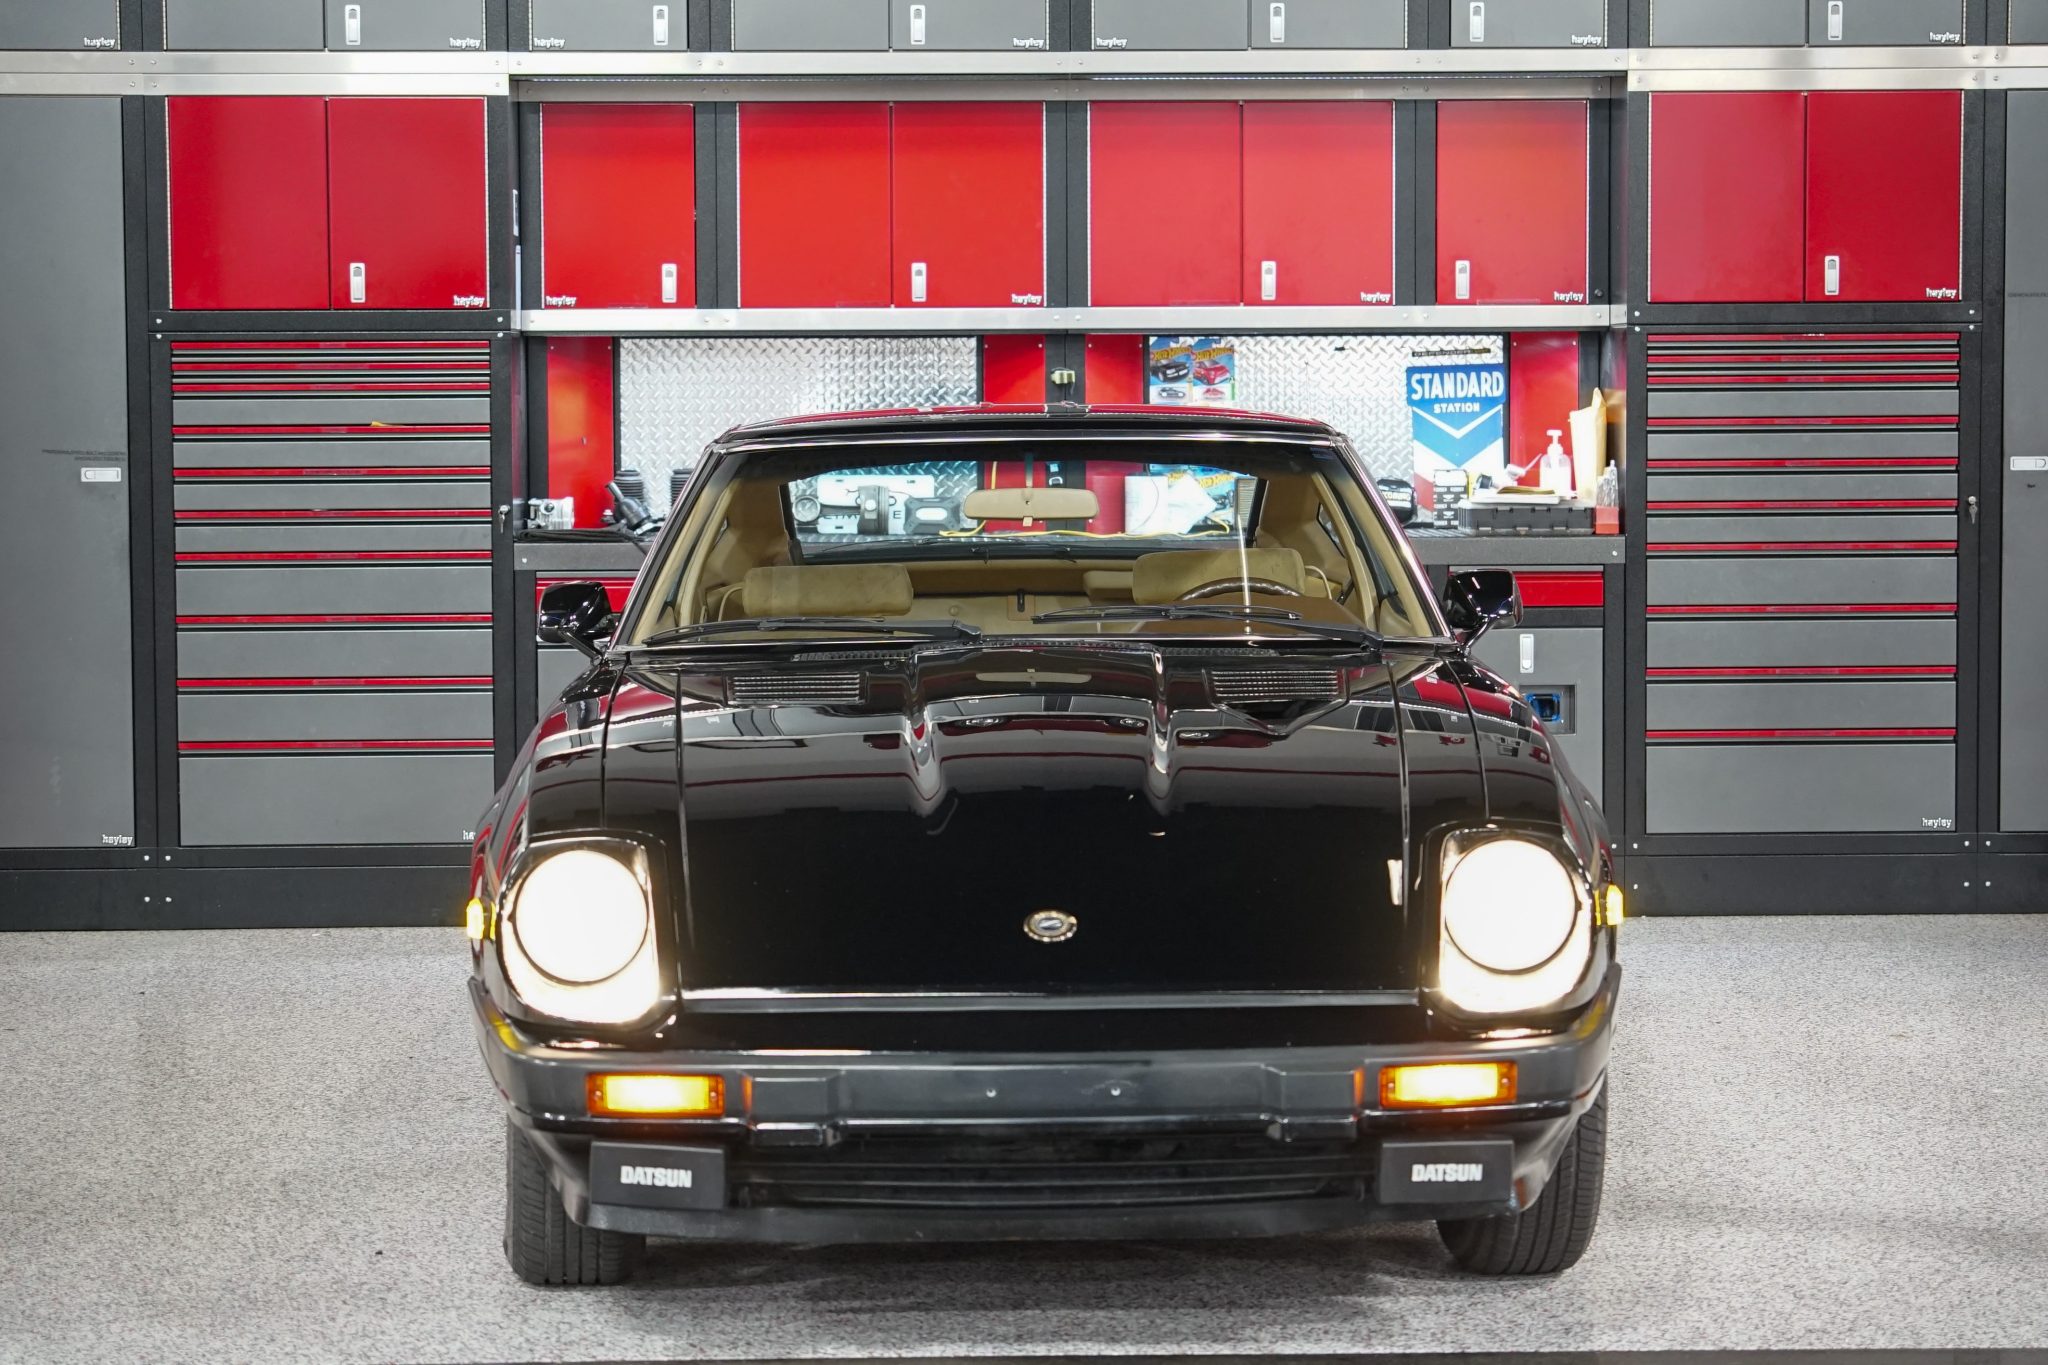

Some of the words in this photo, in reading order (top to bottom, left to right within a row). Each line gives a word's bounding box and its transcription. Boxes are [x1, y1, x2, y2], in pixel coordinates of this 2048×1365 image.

[84, 37, 115, 48] hayley
[449, 37, 481, 49] hayley
[533, 37, 566, 48] hayley
[1013, 37, 1044, 48] hayley
[1096, 37, 1127, 48] hayley
[1571, 34, 1602, 46] hayley
[1929, 32, 1960, 43] hayley
[1011, 293, 1042, 304] hayley
[1360, 291, 1391, 303] hayley
[1553, 291, 1584, 302] hayley
[1926, 287, 1957, 299] hayley
[453, 295, 485, 307] hayley
[546, 295, 577, 306] hayley
[1411, 371, 1504, 400] STANDARD
[1433, 402, 1480, 414] STATION
[1922, 817, 1952, 829] hayley
[620, 1165, 692, 1188] DATSUN
[1411, 1163, 1483, 1183] DATSUN
